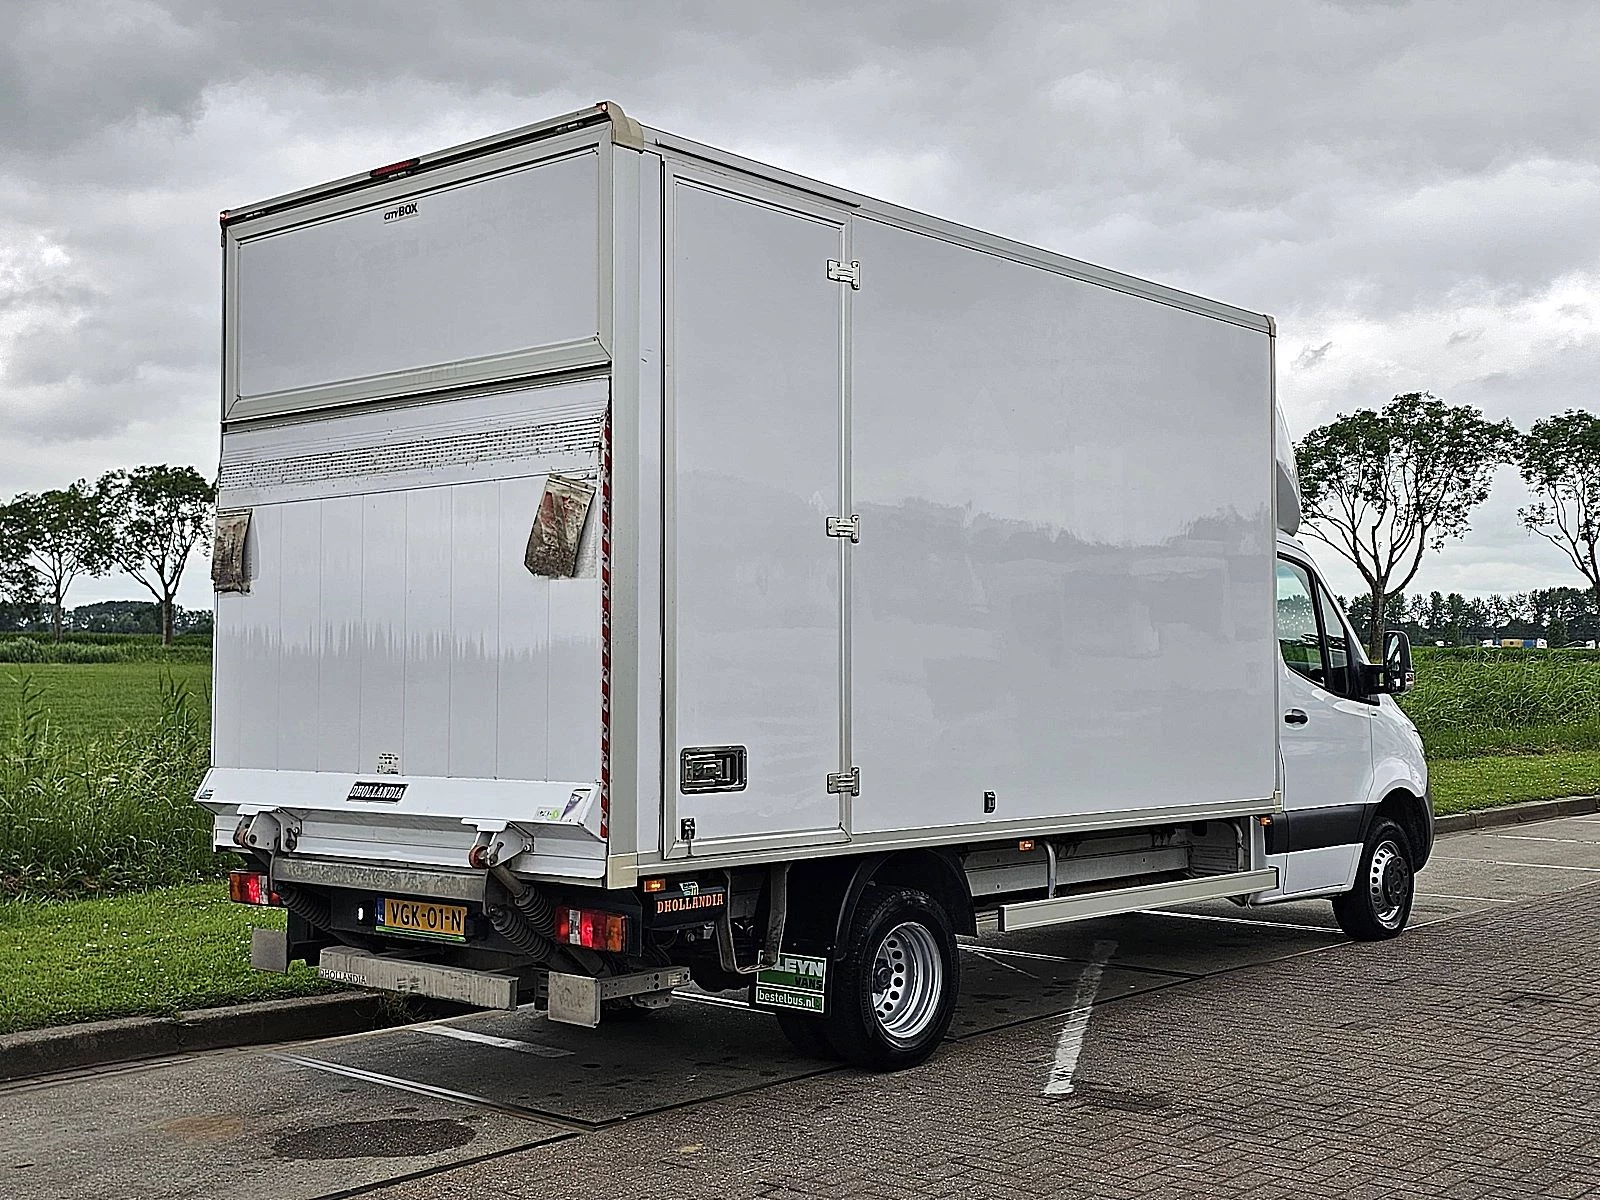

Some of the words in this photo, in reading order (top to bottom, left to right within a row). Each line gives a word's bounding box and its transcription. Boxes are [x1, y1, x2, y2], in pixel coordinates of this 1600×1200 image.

[350, 785, 404, 799] DHOLLANDIA
[657, 893, 723, 914] DHOLLANDIA
[391, 902, 462, 932] VGK-01-N
[761, 954, 824, 977] LEYN
[795, 975, 823, 990] VANS
[759, 989, 815, 1009] bestelbus.nl
